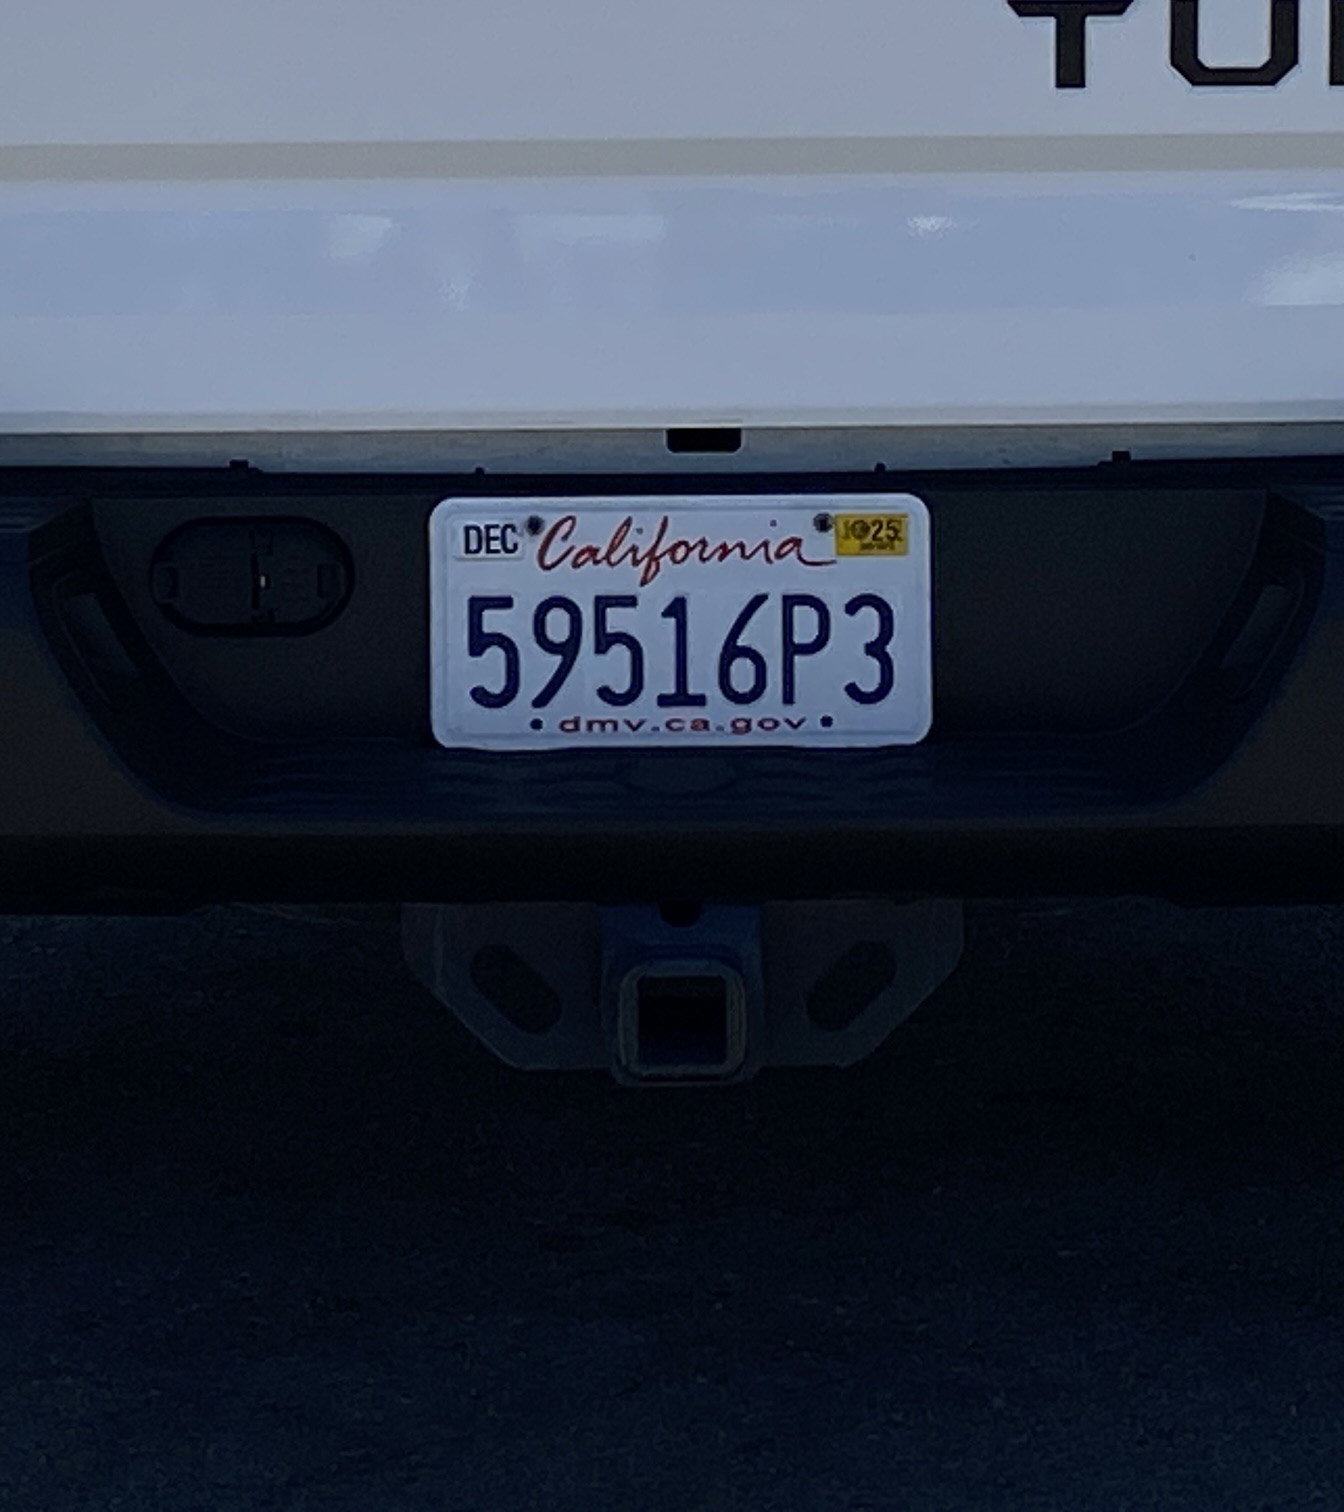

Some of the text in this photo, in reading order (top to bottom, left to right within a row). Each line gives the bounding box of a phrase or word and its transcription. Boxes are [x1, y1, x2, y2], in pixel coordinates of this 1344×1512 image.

[464, 523, 519, 555] DEC
[536, 514, 837, 587] California
[467, 593, 895, 709] 59516P3
[559, 715, 807, 736] dmv.ca.gov
